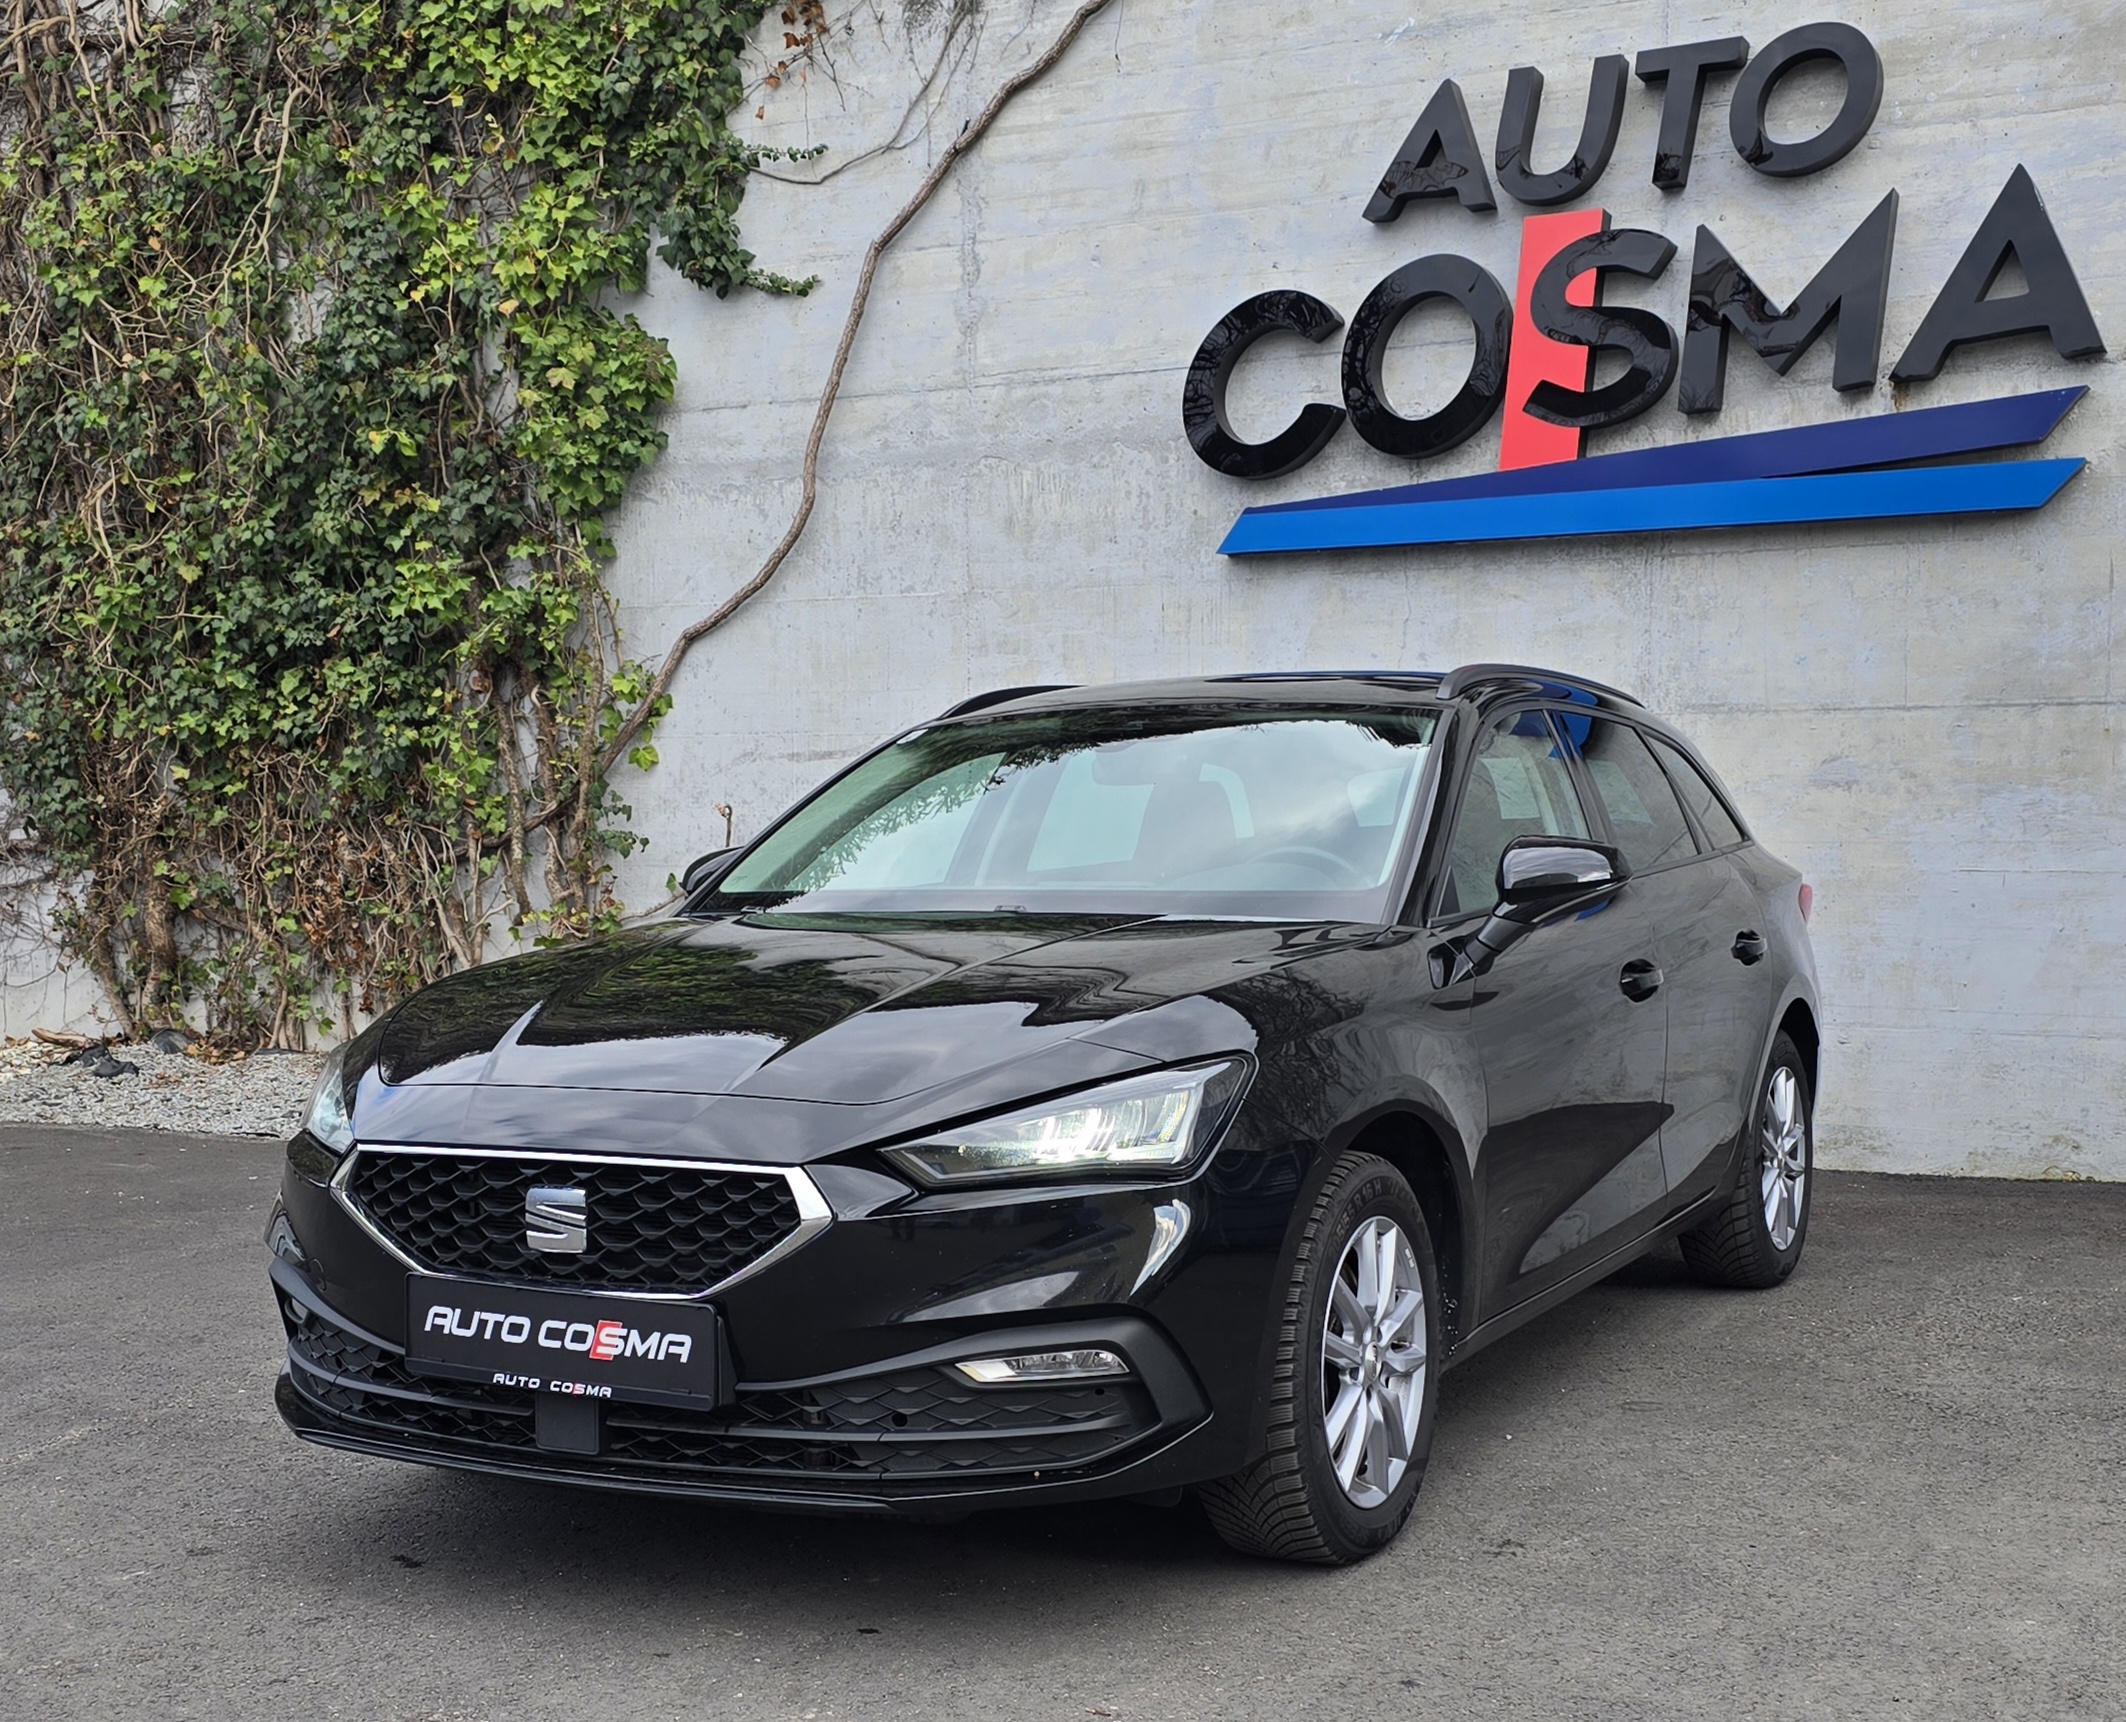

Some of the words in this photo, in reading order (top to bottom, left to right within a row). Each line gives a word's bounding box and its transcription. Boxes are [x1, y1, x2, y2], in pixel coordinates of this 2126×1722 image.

[1362, 21, 1884, 224] AUTO
[1182, 162, 2107, 481] COSMA
[1362, 1183, 1373, 1202] 16
[424, 1305, 531, 1344] AUTO
[538, 1319, 692, 1363] COSMA
[493, 1373, 541, 1389] AUTO
[550, 1380, 612, 1398] COSMA
